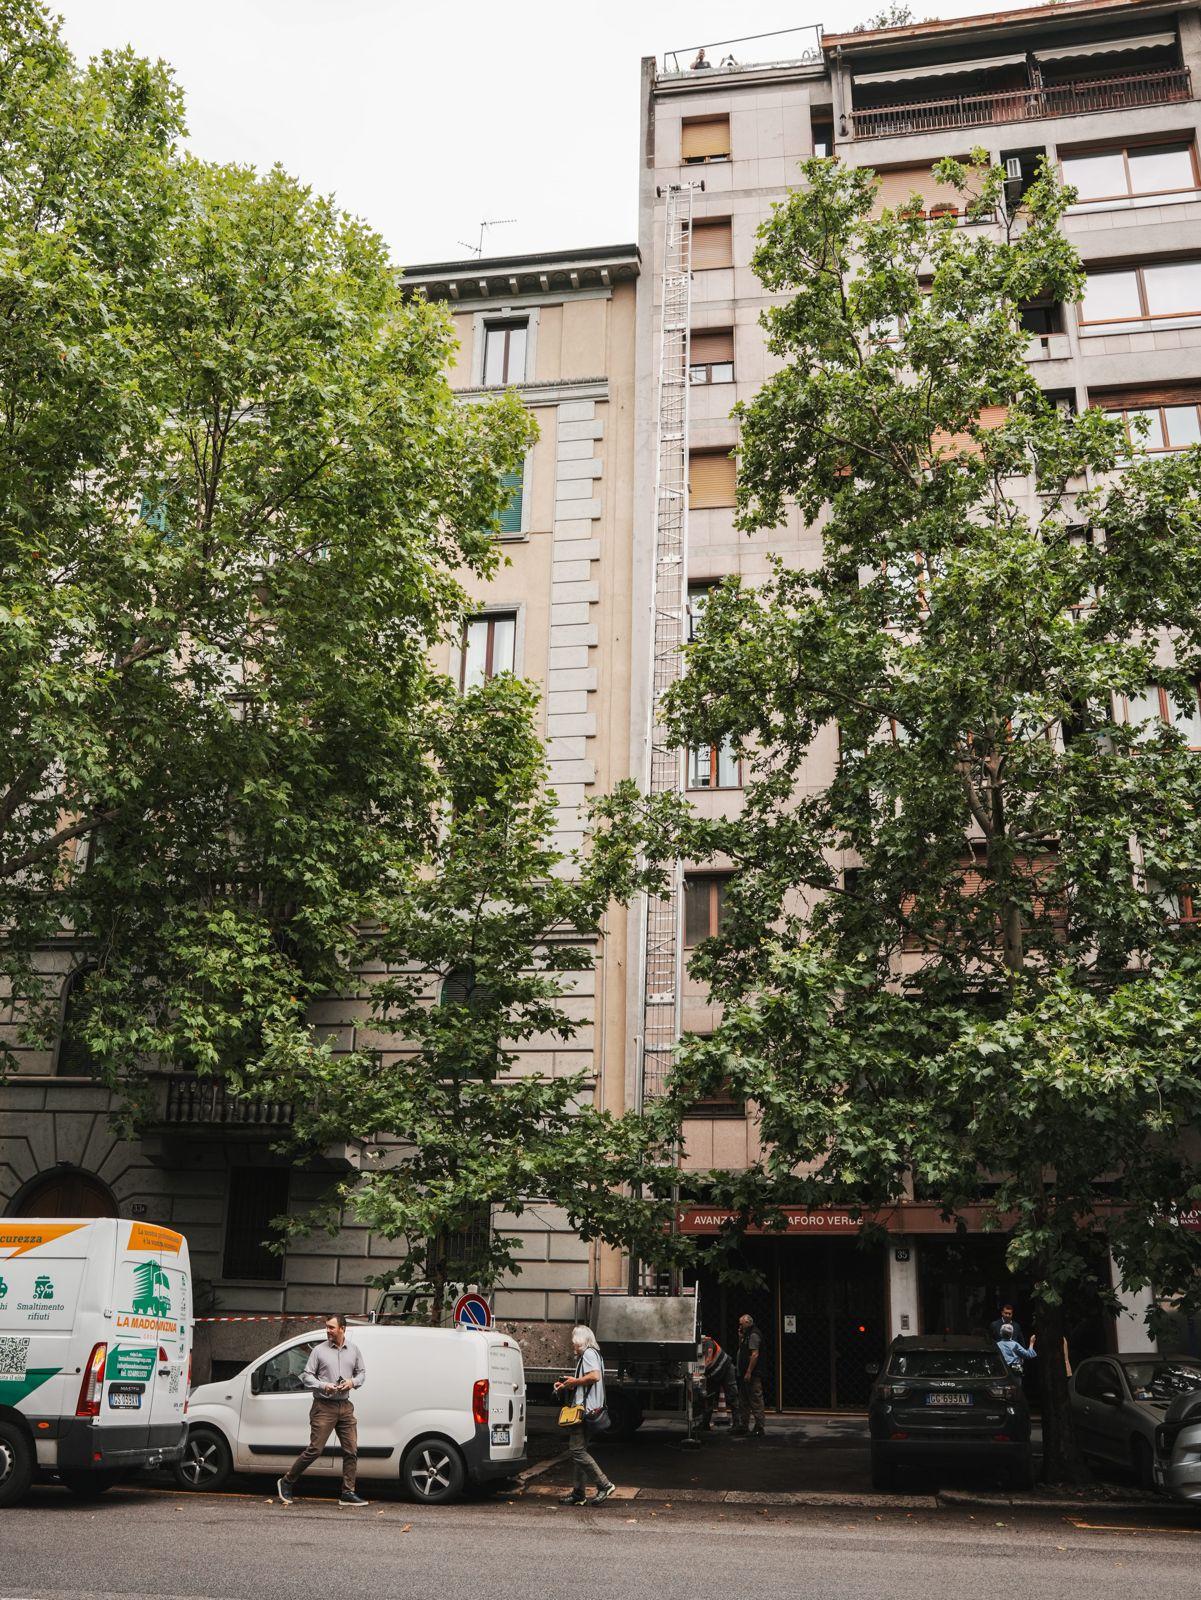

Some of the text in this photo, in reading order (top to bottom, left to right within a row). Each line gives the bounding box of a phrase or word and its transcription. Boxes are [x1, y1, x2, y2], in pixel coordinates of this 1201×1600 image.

[694, 1215, 741, 1225] AVANZ
[897, 1250, 908, 1259] 35
[0, 1302, 8, 1311] hi
[16, 1302, 65, 1311] Smaltimento
[27, 1312, 50, 1321] rifiuti
[116, 1315, 129, 1328] LA
